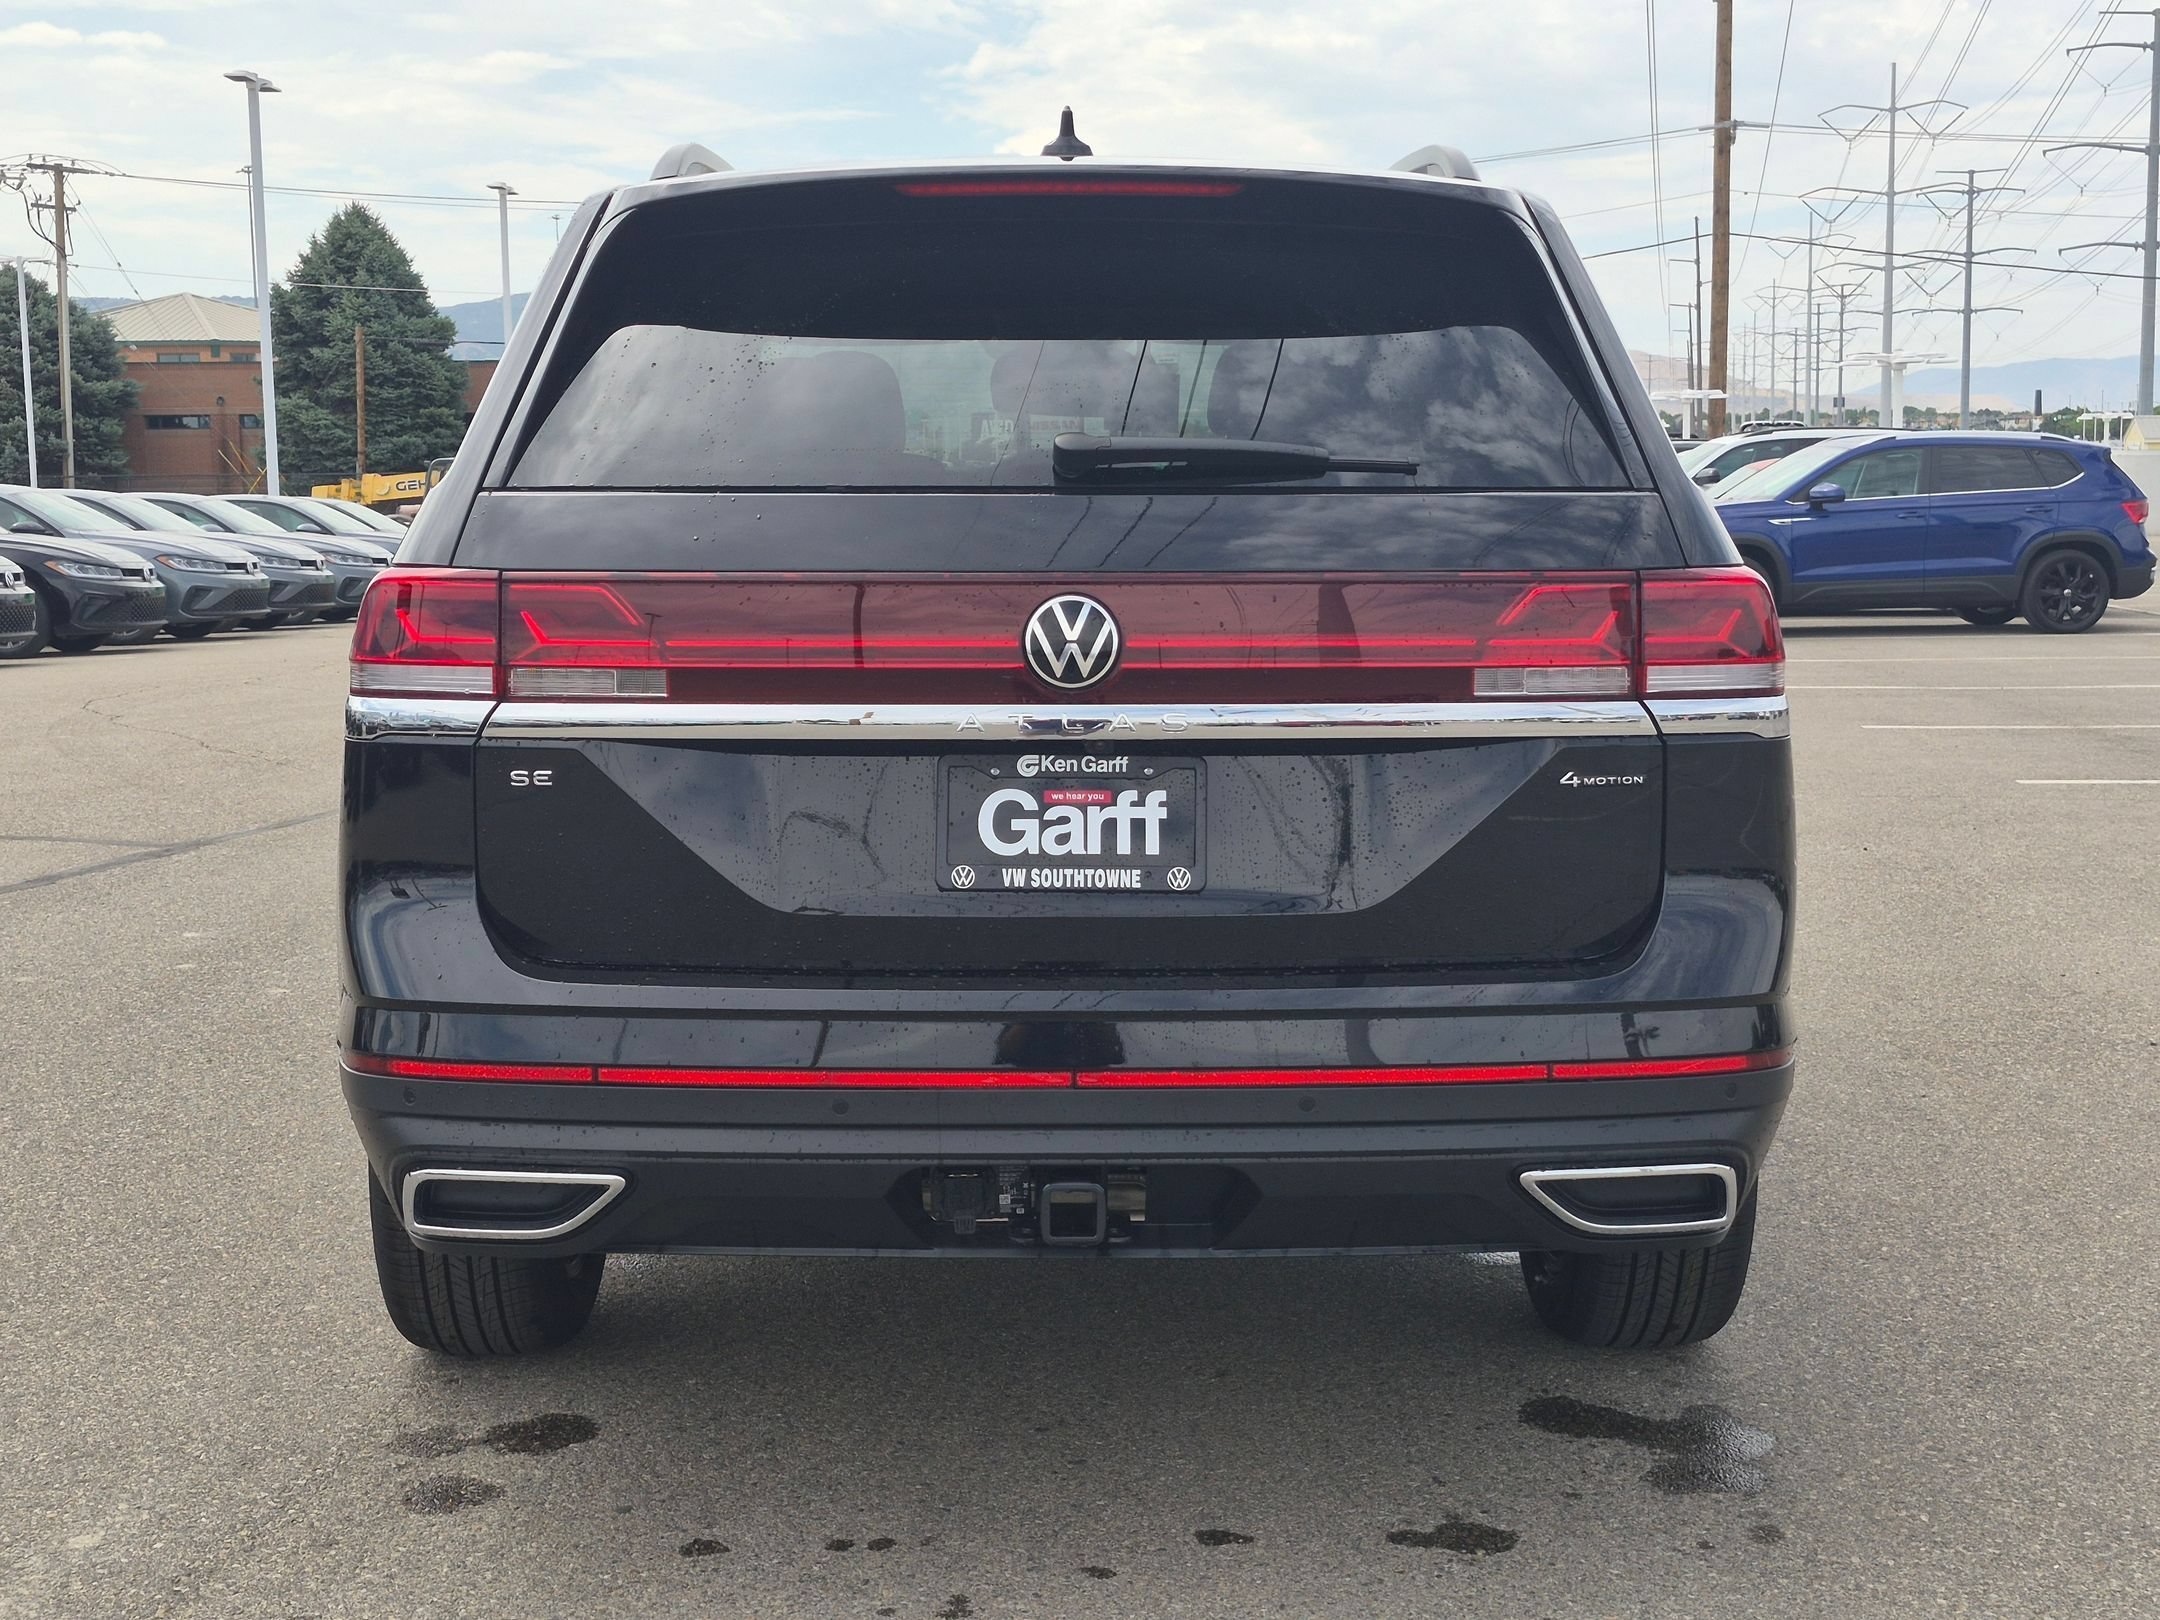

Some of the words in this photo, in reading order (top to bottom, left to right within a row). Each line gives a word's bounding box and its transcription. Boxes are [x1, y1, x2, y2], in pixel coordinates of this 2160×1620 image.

[396, 480, 426, 491] GEH
[956, 713, 1190, 733] ATLAS
[1041, 755, 1078, 772] Ken
[1081, 756, 1129, 773] Garff
[510, 770, 553, 786] SE
[1560, 771, 1645, 788] 4MOTION
[1066, 791, 1085, 800] hear
[1088, 793, 1104, 802] you
[977, 788, 1168, 856] Garff
[1002, 868, 1027, 887] VW
[1030, 868, 1142, 888] SOUTHTOWNE
